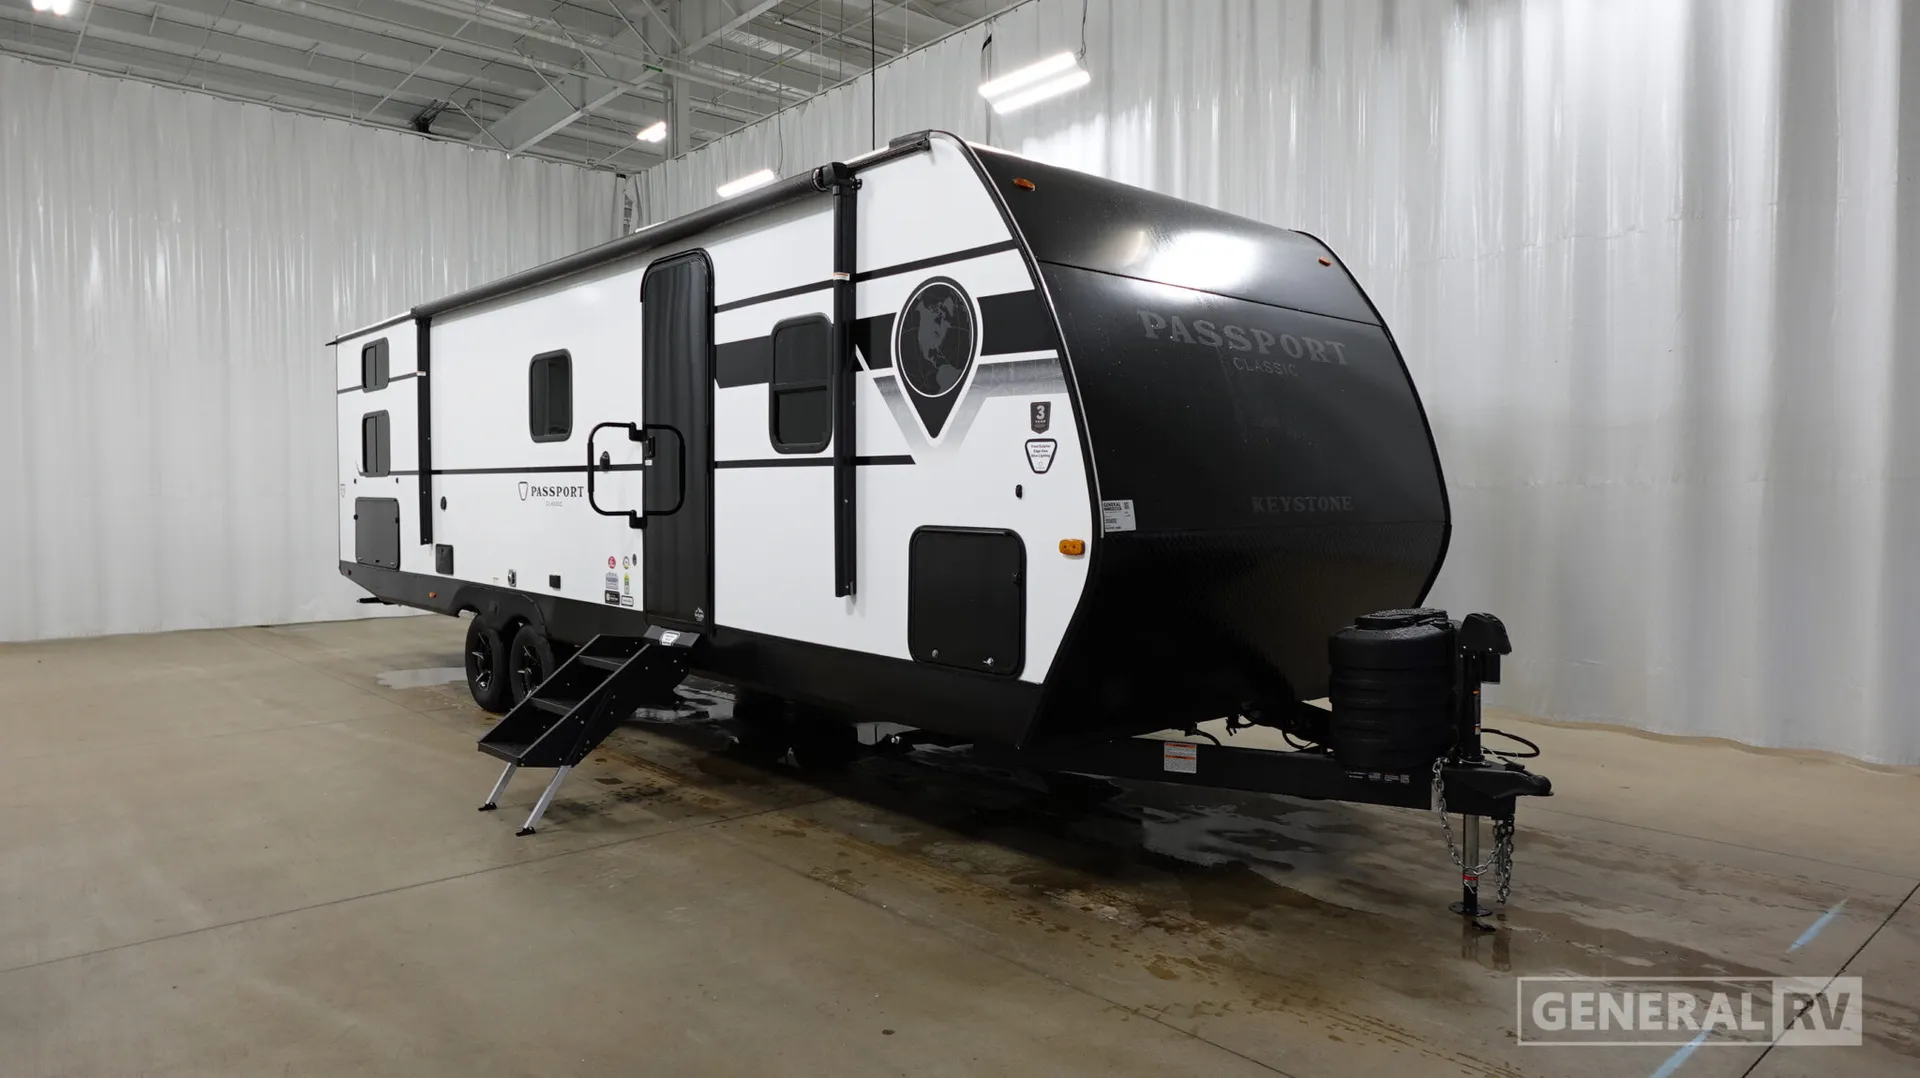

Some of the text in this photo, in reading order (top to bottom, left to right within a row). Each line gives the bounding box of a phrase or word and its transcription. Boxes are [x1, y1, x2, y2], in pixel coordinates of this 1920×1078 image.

[1136, 309, 1349, 366] PASSPORT
[1233, 357, 1299, 377] CLASSIC
[1036, 405, 1045, 420] 3
[531, 486, 584, 498] PASSPORT
[1251, 496, 1354, 514] KEYSTONE
